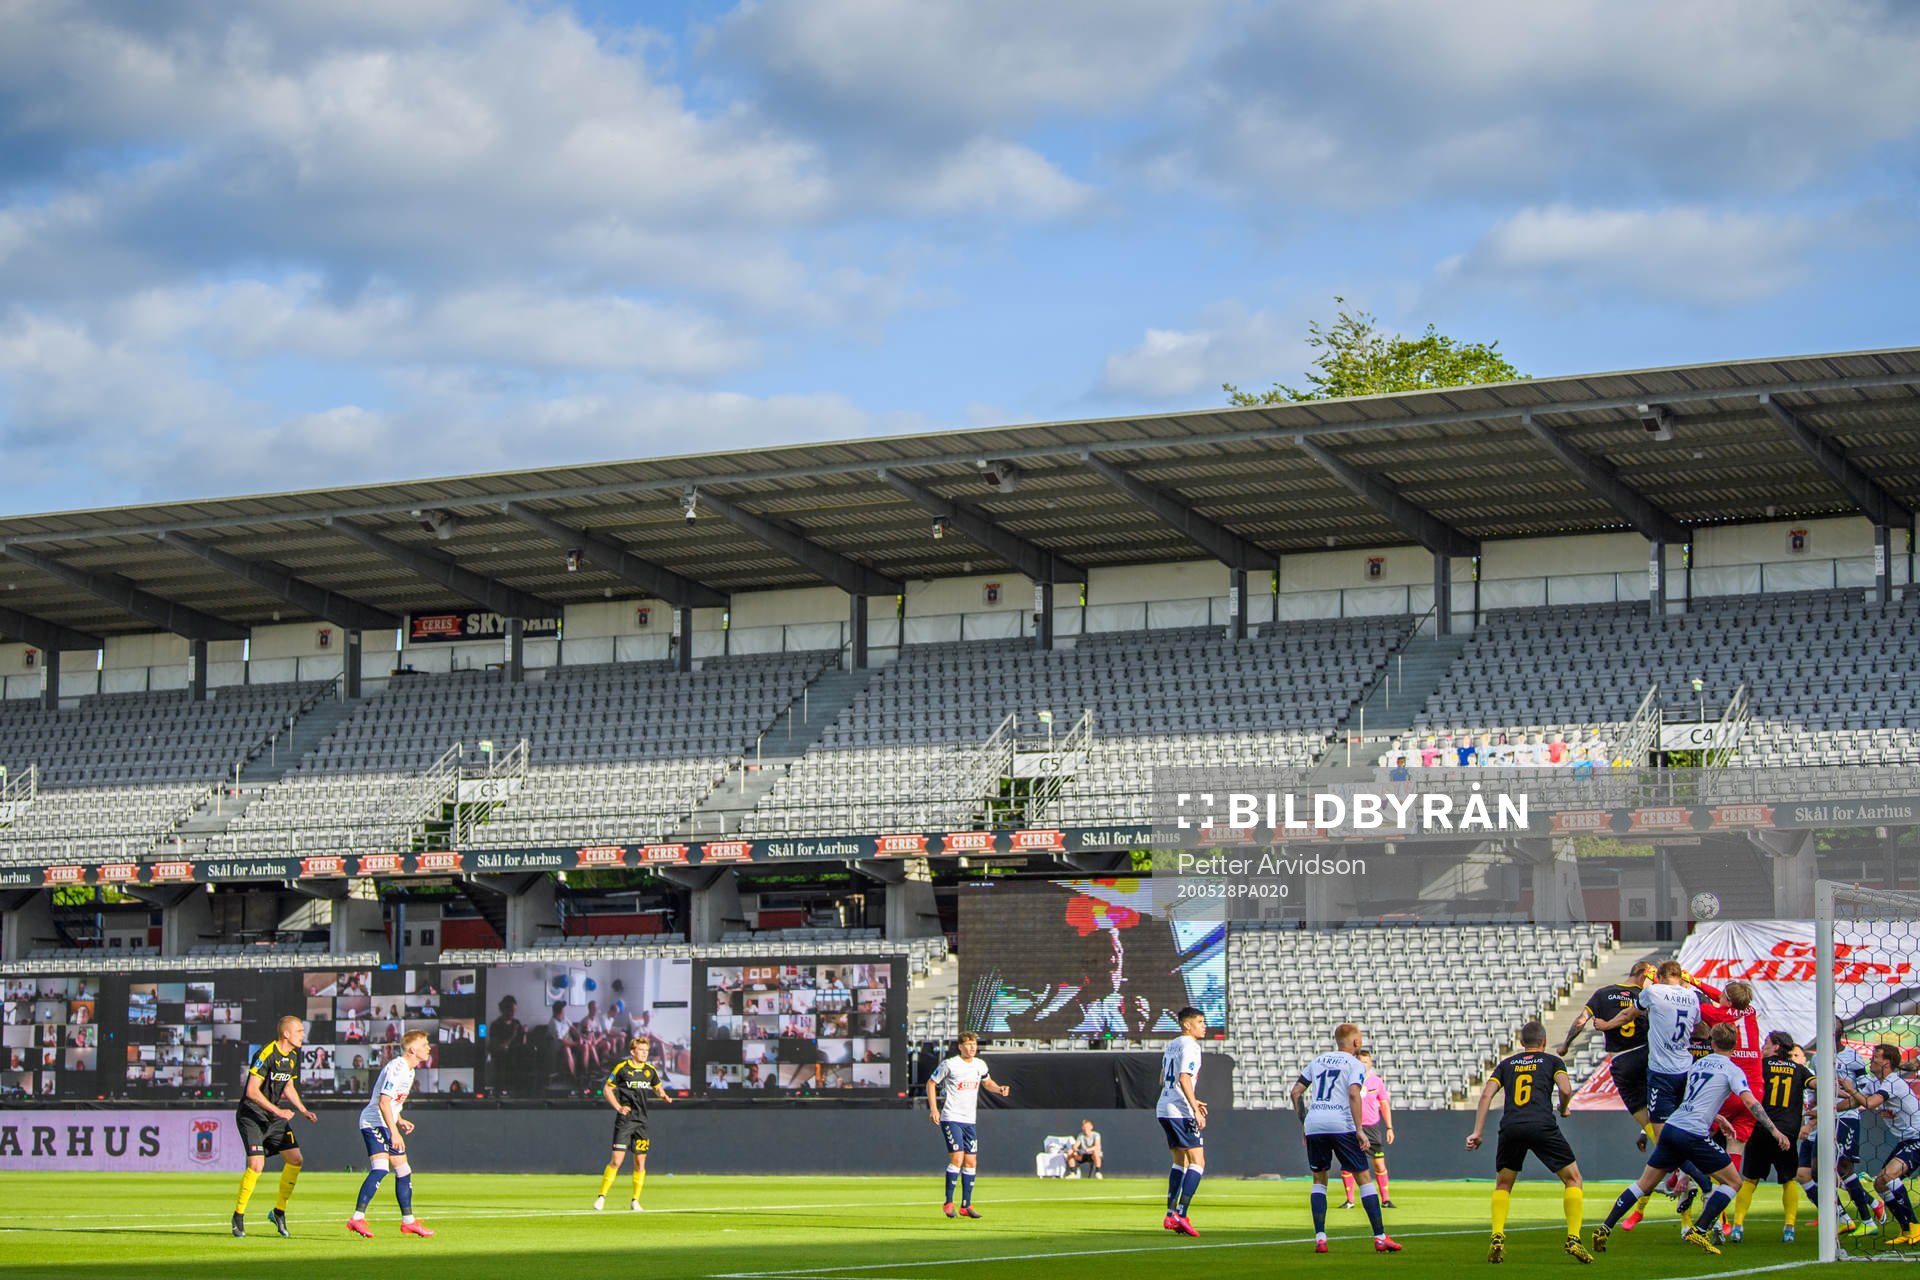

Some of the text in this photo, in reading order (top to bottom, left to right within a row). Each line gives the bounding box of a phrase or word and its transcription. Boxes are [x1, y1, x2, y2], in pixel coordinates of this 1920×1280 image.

[422, 619, 453, 630] CERES
[1690, 728, 1713, 745] C4
[1039, 757, 1060, 772] C5
[1640, 811, 1681, 825] CERES
[1721, 808, 1762, 822] CERES
[1794, 804, 1912, 822] Skål for Aarhus
[1561, 814, 1600, 828] CERES
[884, 838, 918, 851] CERES
[951, 836, 986, 848] CERES
[1019, 833, 1055, 846] CERES
[1081, 829, 1181, 847] Skål for Aarhus
[585, 848, 617, 862] CERES
[647, 847, 680, 860] CERES
[710, 845, 744, 858] CERES
[768, 840, 860, 857] Skål for Aarhus
[308, 858, 338, 871] CERES
[366, 857, 396, 869] CERES
[424, 855, 455, 867] CERES
[477, 852, 562, 868] Skål for Aarhus
[51, 868, 78, 880] CERES
[104, 867, 132, 878] CERES
[158, 865, 187, 877] CERES
[207, 861, 287, 877] Skål for Aarhus
[1671, 1009, 1689, 1042] 5
[1734, 1016, 1749, 1049] 1
[270, 1071, 291, 1081] VERD
[1316, 1069, 1341, 1102] 17
[1514, 1073, 1533, 1107] 6
[1769, 1075, 1793, 1108] 11
[0, 1125, 161, 1157] ARHUS
[287, 1130, 295, 1144] 7
